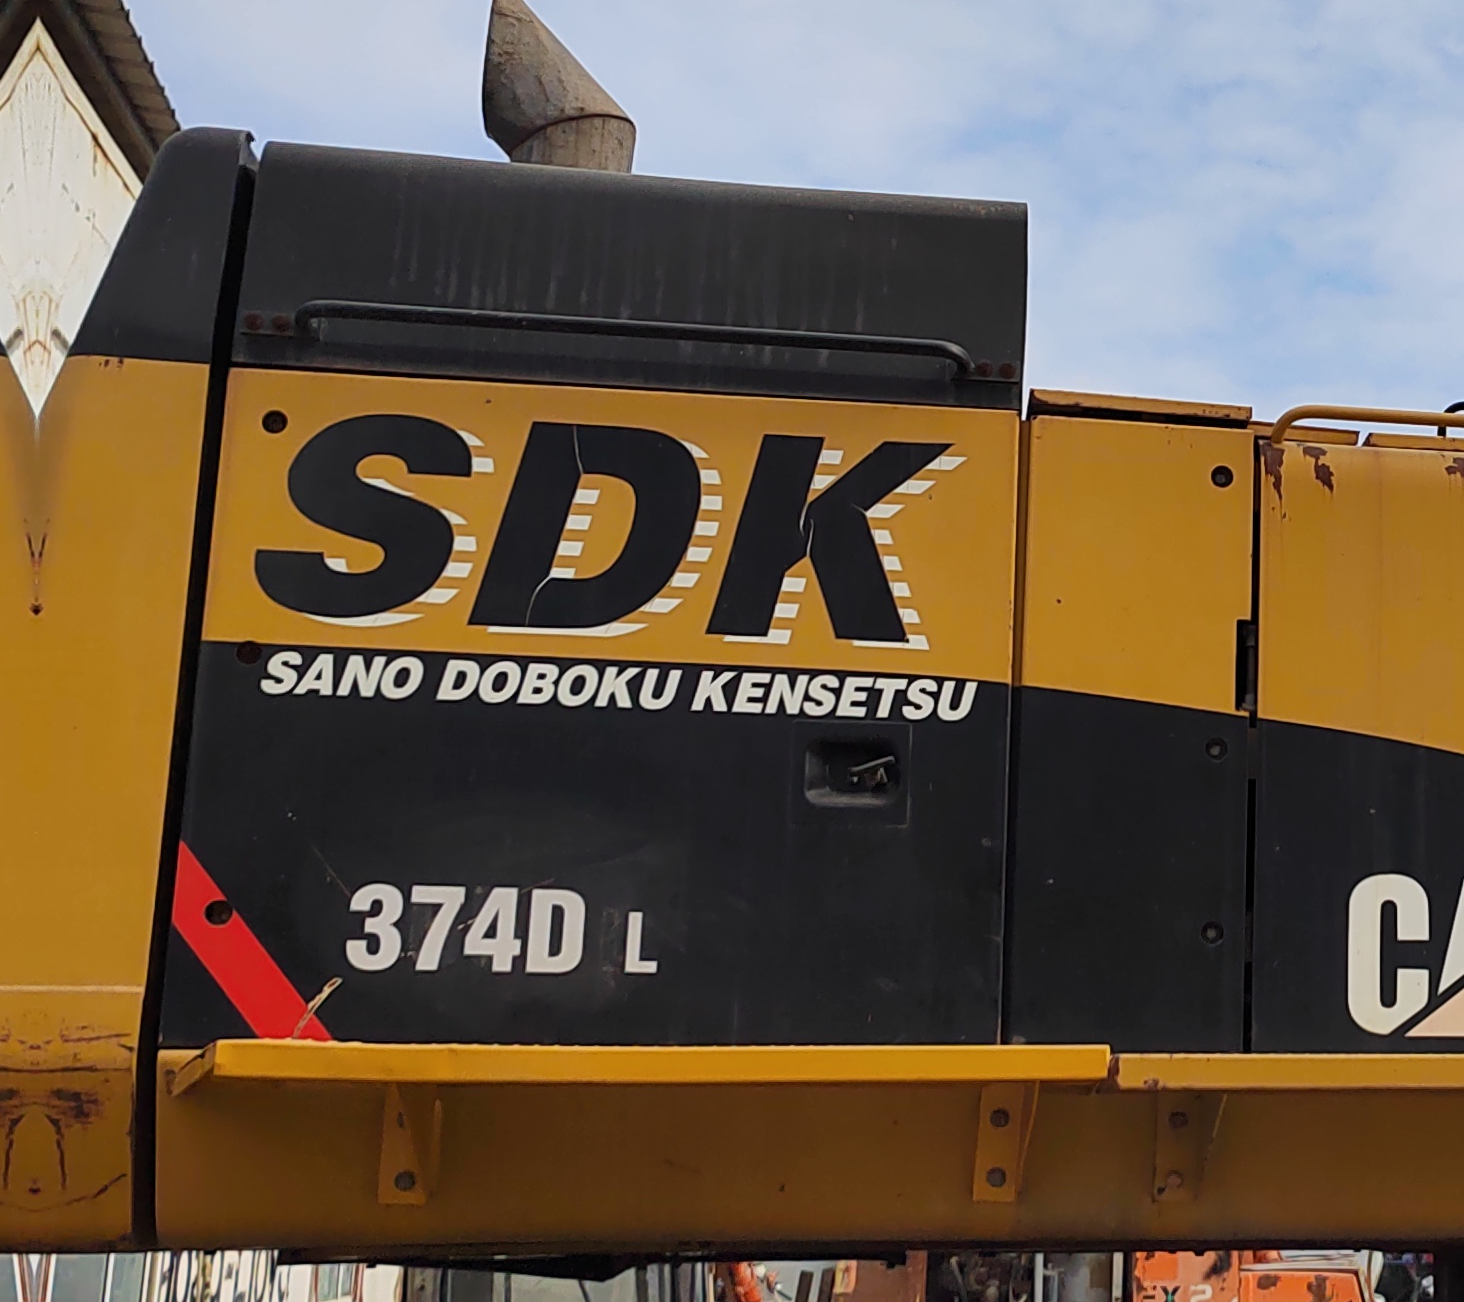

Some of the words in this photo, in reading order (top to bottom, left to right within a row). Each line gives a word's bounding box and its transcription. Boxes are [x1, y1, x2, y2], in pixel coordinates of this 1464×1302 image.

[254, 413, 967, 650] SDK
[259, 650, 425, 700] SANO
[435, 659, 683, 712] DOBOKU
[690, 669, 979, 722] KENSETSU
[345, 882, 586, 974] 374D
[624, 910, 659, 974] L
